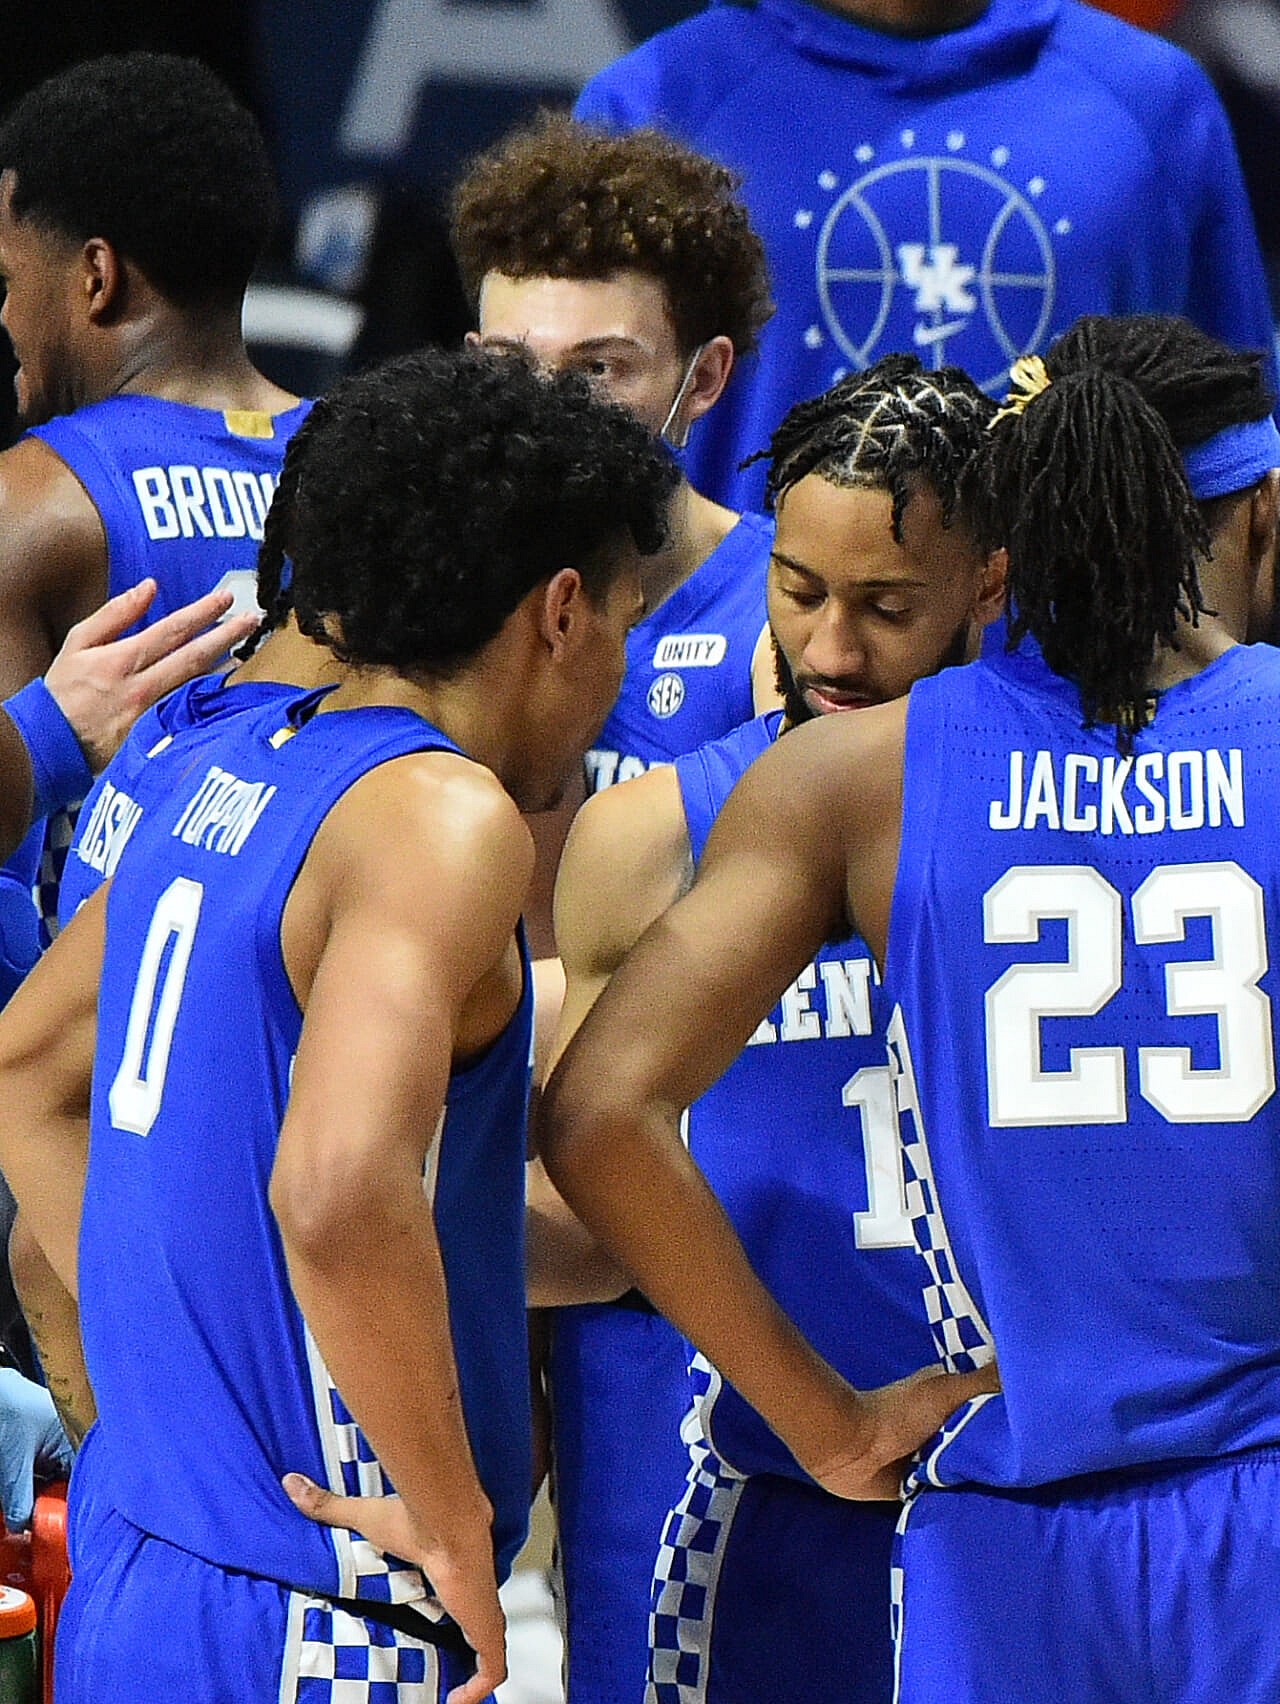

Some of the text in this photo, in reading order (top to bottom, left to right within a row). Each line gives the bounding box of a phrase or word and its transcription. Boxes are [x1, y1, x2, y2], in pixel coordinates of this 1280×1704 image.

[661, 639, 717, 663] UNITY
[171, 765, 278, 857] TOPPIN
[988, 748, 1246, 835] JACKSON
[108, 876, 204, 1138] 0
[982, 860, 1277, 1128] 23
